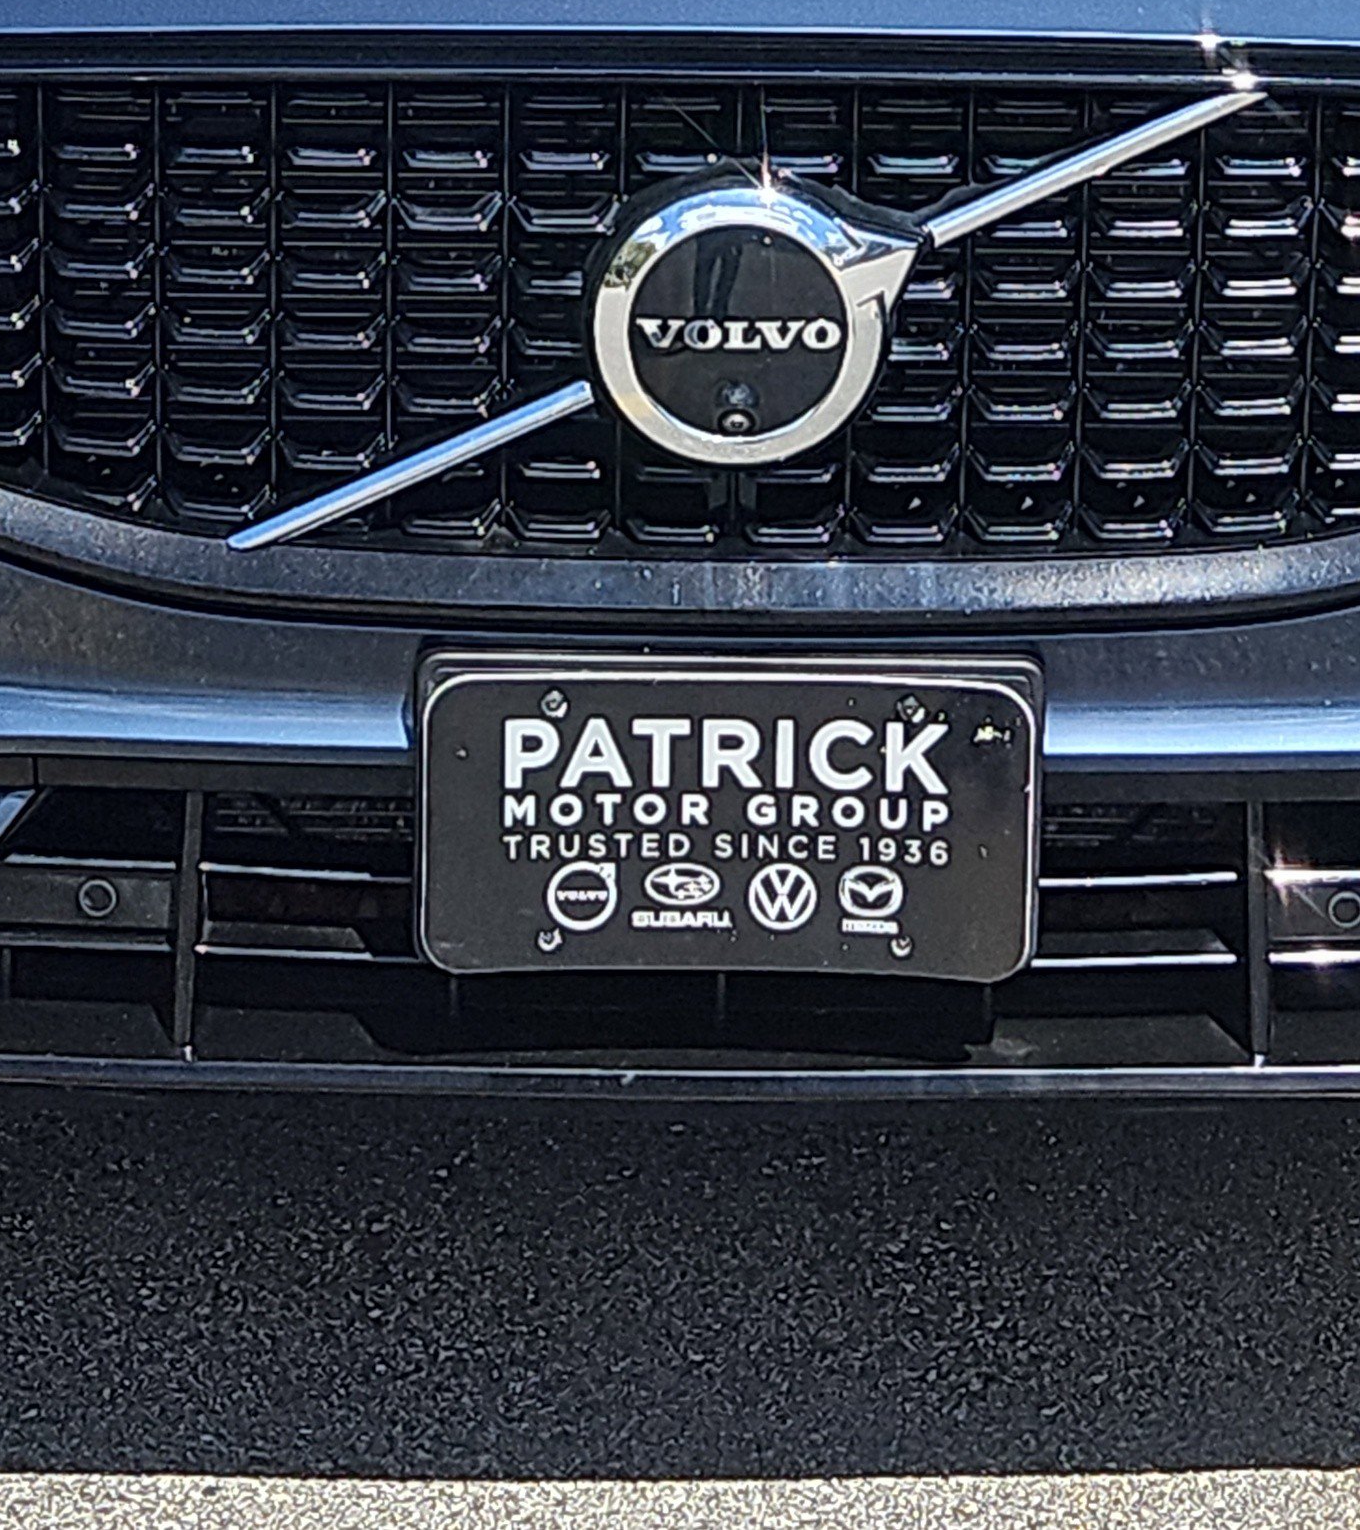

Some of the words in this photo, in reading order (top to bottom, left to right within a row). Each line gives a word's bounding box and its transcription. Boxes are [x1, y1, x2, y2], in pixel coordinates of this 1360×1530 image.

[636, 317, 843, 351] VOLVO
[504, 717, 950, 795] PATRICK
[503, 792, 710, 828] MOTOR
[746, 793, 950, 832] GROUP
[502, 832, 691, 860] TRUSTED
[713, 832, 838, 860] SINCE
[858, 836, 949, 866] 1936
[630, 910, 733, 928] SUBARU
